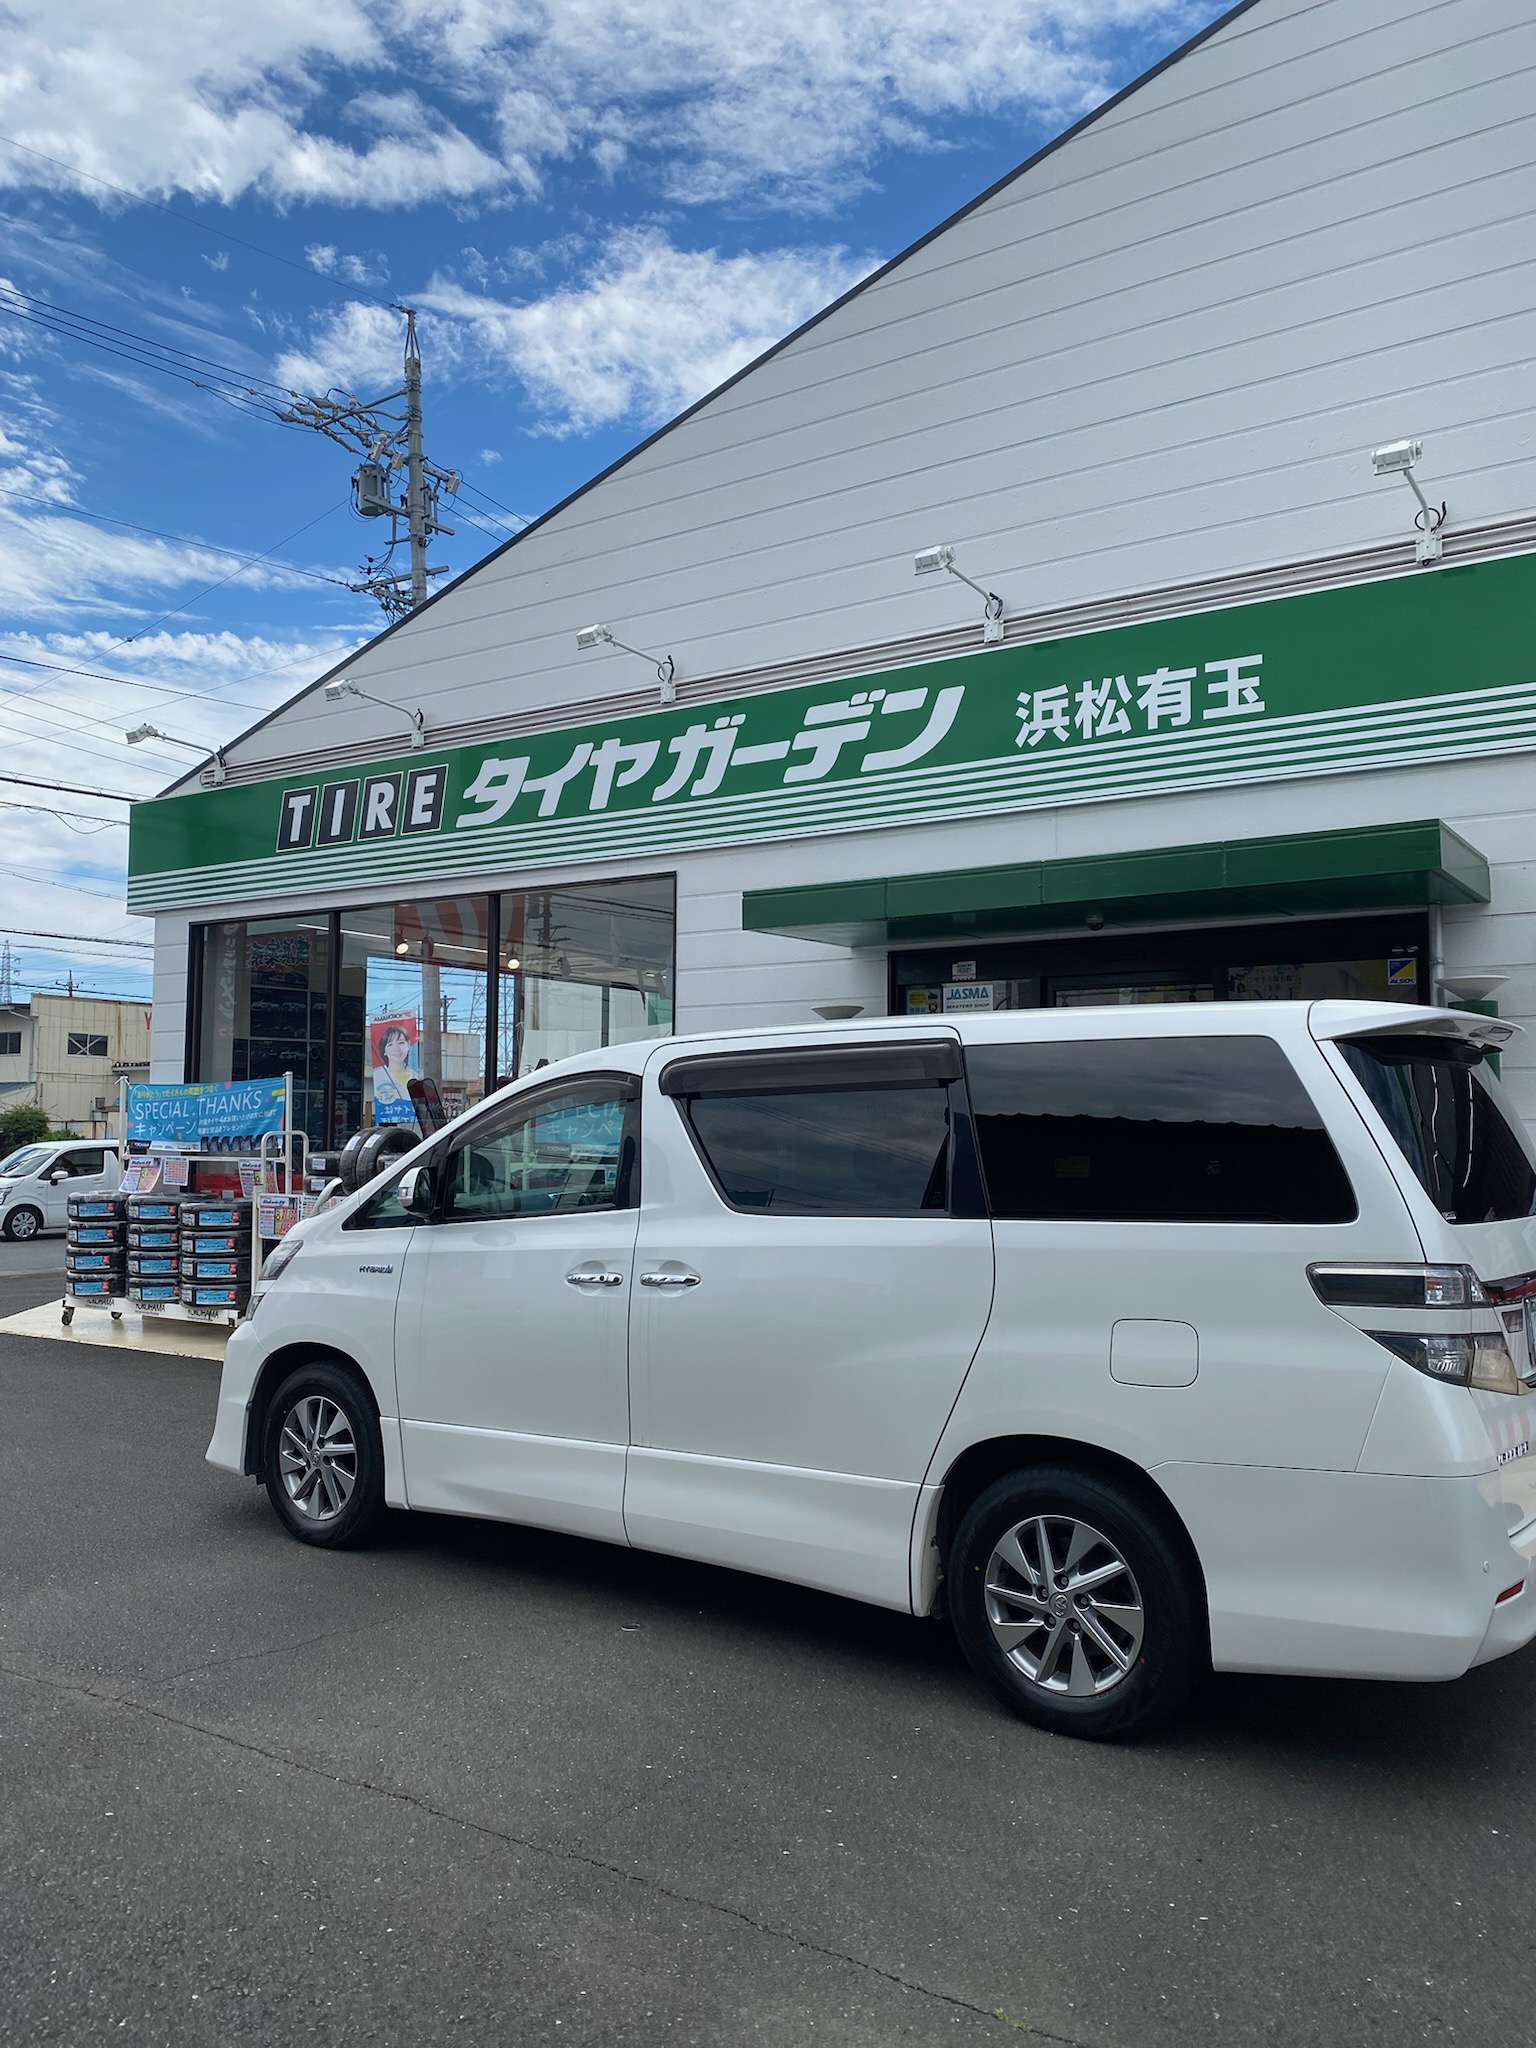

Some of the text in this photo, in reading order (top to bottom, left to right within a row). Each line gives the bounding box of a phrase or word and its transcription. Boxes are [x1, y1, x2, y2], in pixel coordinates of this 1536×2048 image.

[285, 653, 1265, 844] TIRE タイヤガーデン 浜松有玉
[946, 986, 989, 1000] JASMA
[134, 1090, 262, 1120] SPECIAL THANKS
[134, 1120, 197, 1137] キャンペーン
